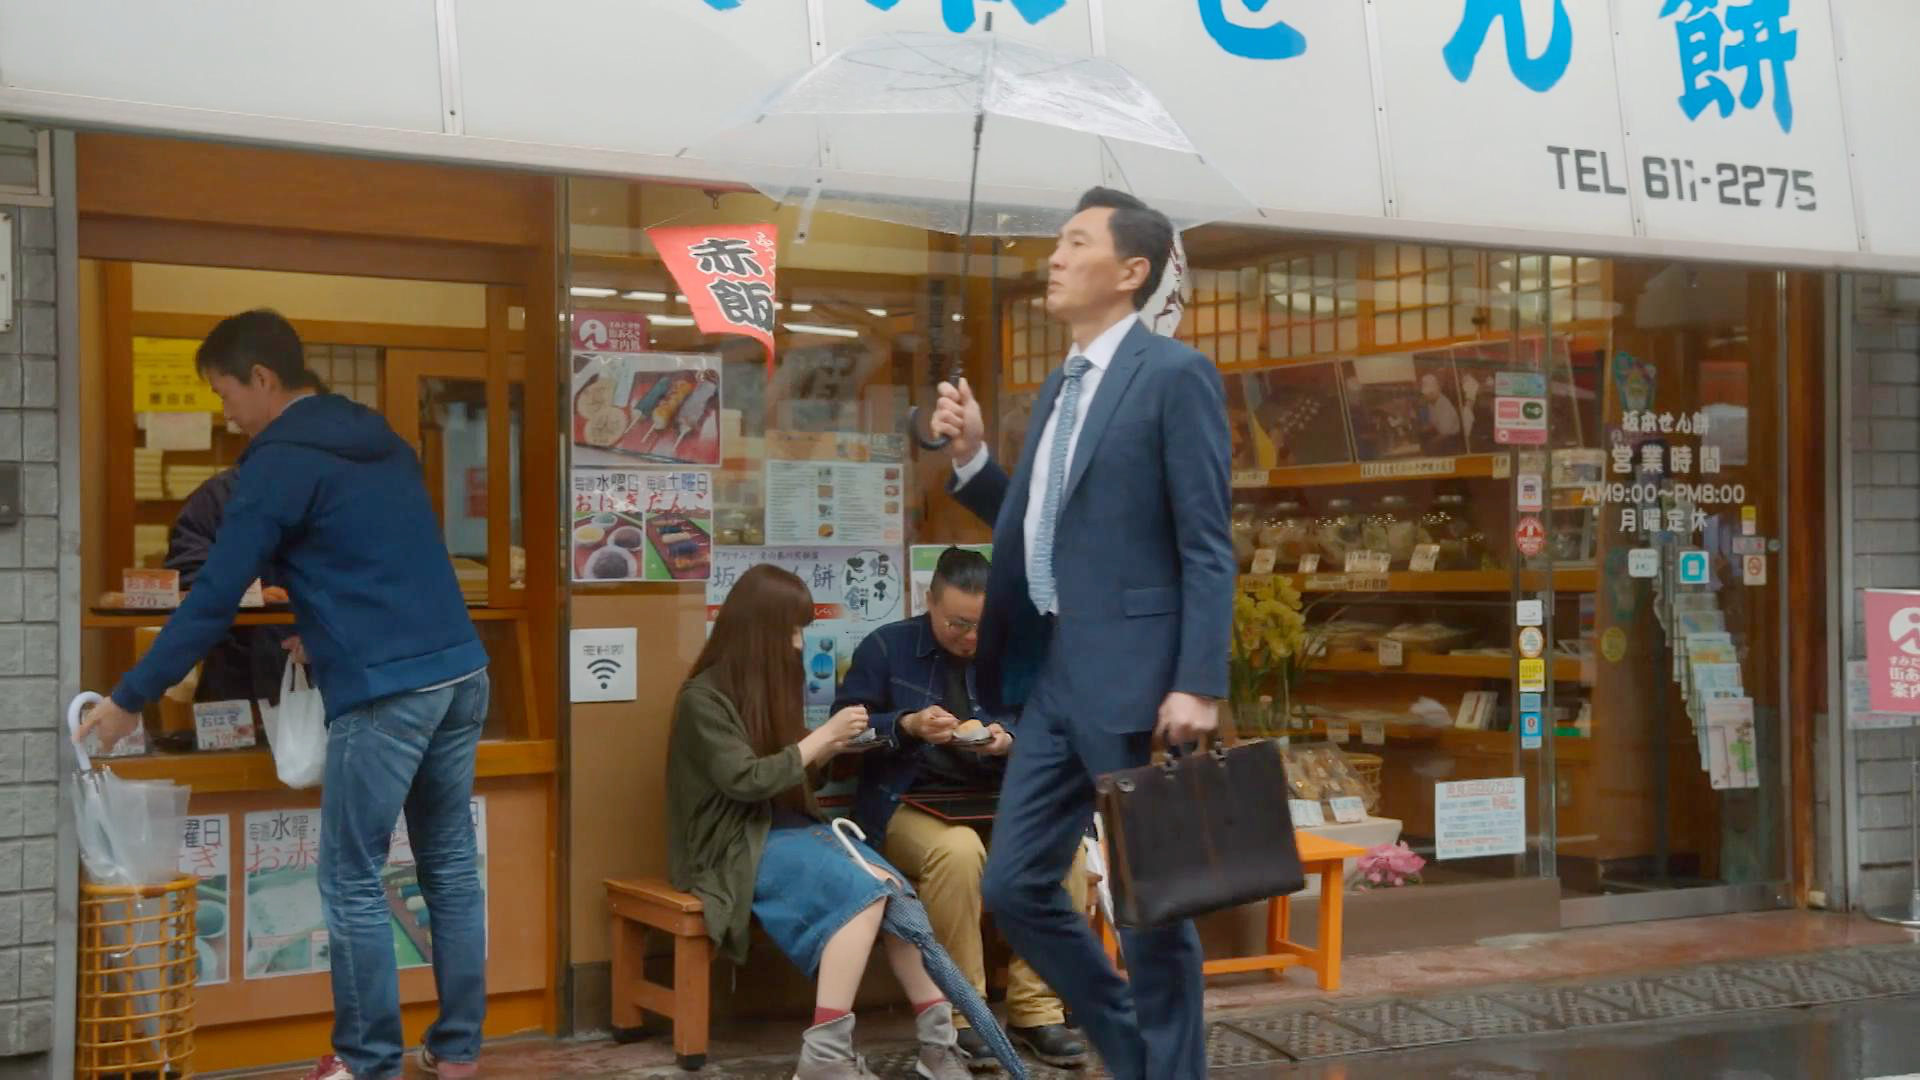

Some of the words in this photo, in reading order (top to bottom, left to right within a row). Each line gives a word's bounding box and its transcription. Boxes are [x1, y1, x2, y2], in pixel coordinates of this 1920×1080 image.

[1547, 145, 1626, 195] TEL
[1642, 156, 1817, 211] 611-2275
[687, 237, 776, 332] 赤飯
[1621, 411, 1710, 434] 坂本せん餅
[1612, 444, 1721, 474] 営業時間
[1620, 508, 1709, 533] 月曜定休
